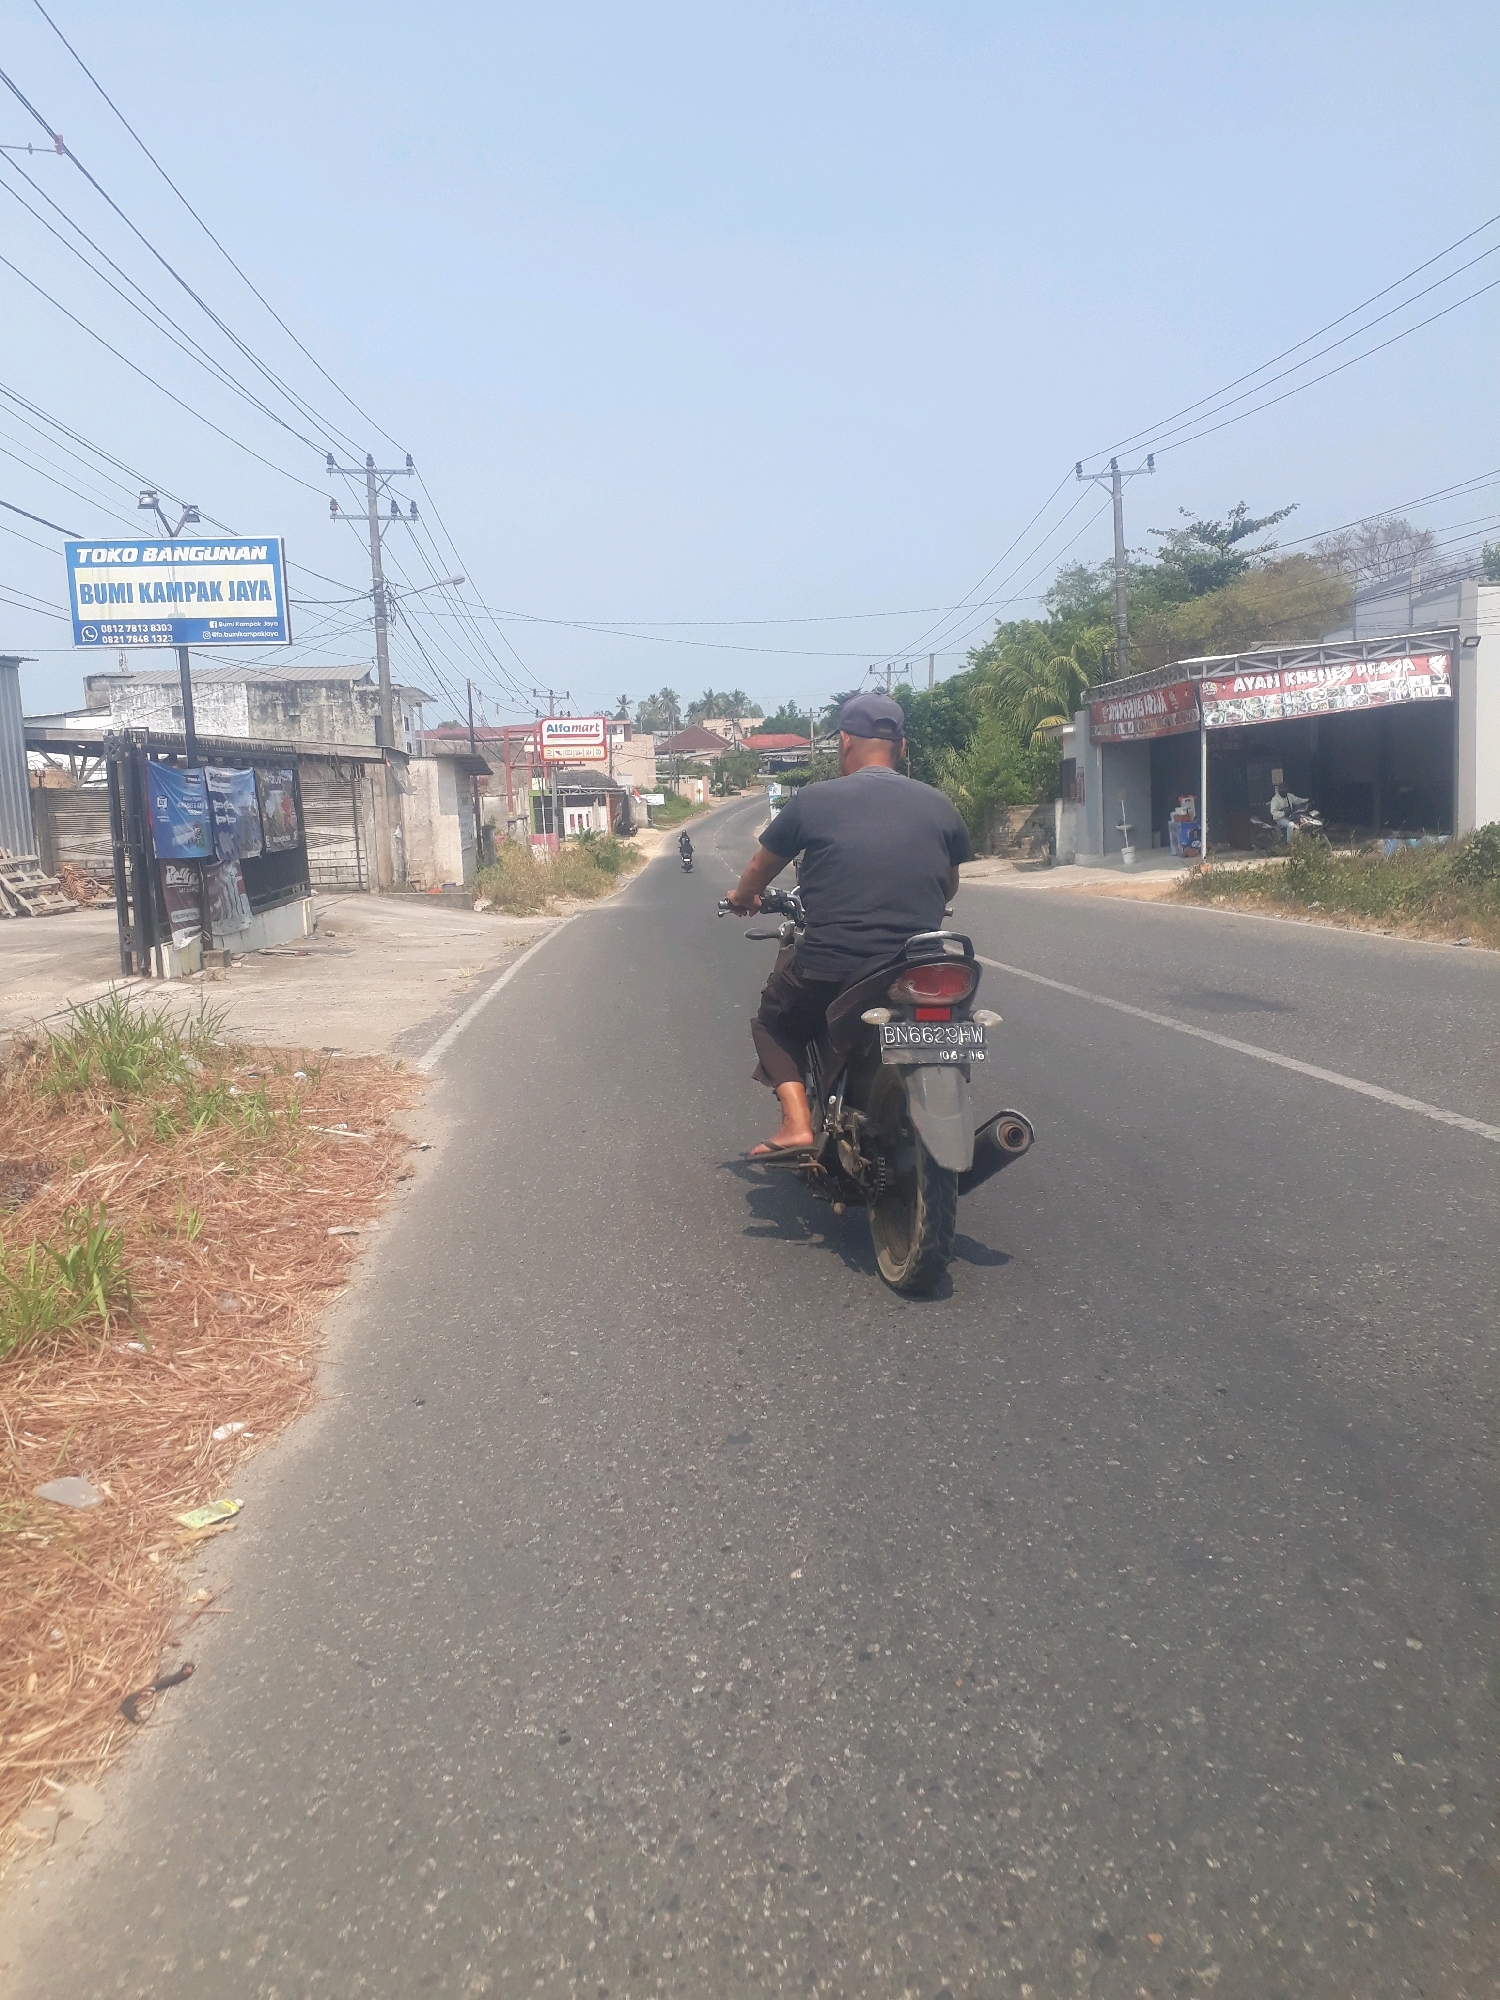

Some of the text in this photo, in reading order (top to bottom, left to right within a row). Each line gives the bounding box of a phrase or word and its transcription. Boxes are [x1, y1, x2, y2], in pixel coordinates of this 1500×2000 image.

[77, 545, 268, 563] TOKO BANGUNAN
[79, 579, 273, 605] BUMI KAMPAK JAYA
[101, 623, 173, 633] 0812 7813 8303
[102, 634, 174, 644] 0821 7848 1323
[1233, 672, 1281, 693] AYAM
[546, 722, 601, 733] Alfamart
